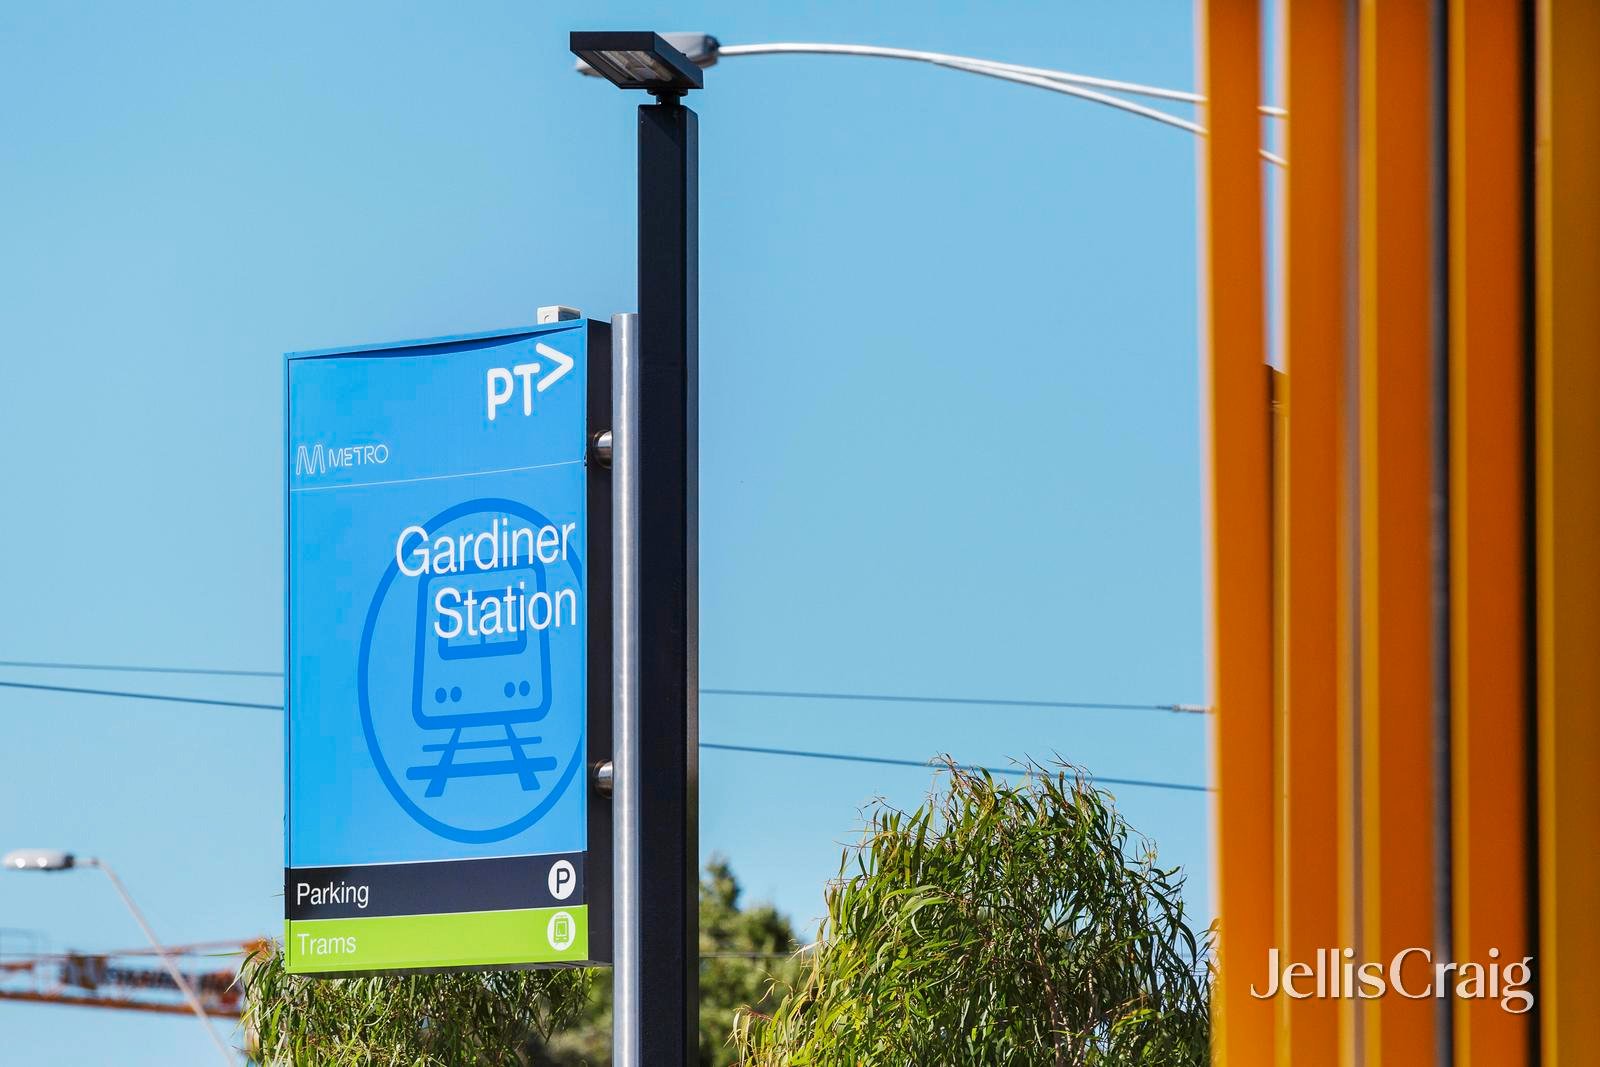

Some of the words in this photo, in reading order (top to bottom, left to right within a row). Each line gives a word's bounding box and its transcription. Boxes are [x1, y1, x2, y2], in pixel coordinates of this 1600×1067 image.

[328, 444, 389, 468] METRO
[396, 517, 576, 577] Gardiner
[434, 581, 576, 638] Station
[297, 880, 369, 909] Parking
[297, 933, 357, 956] Trams
